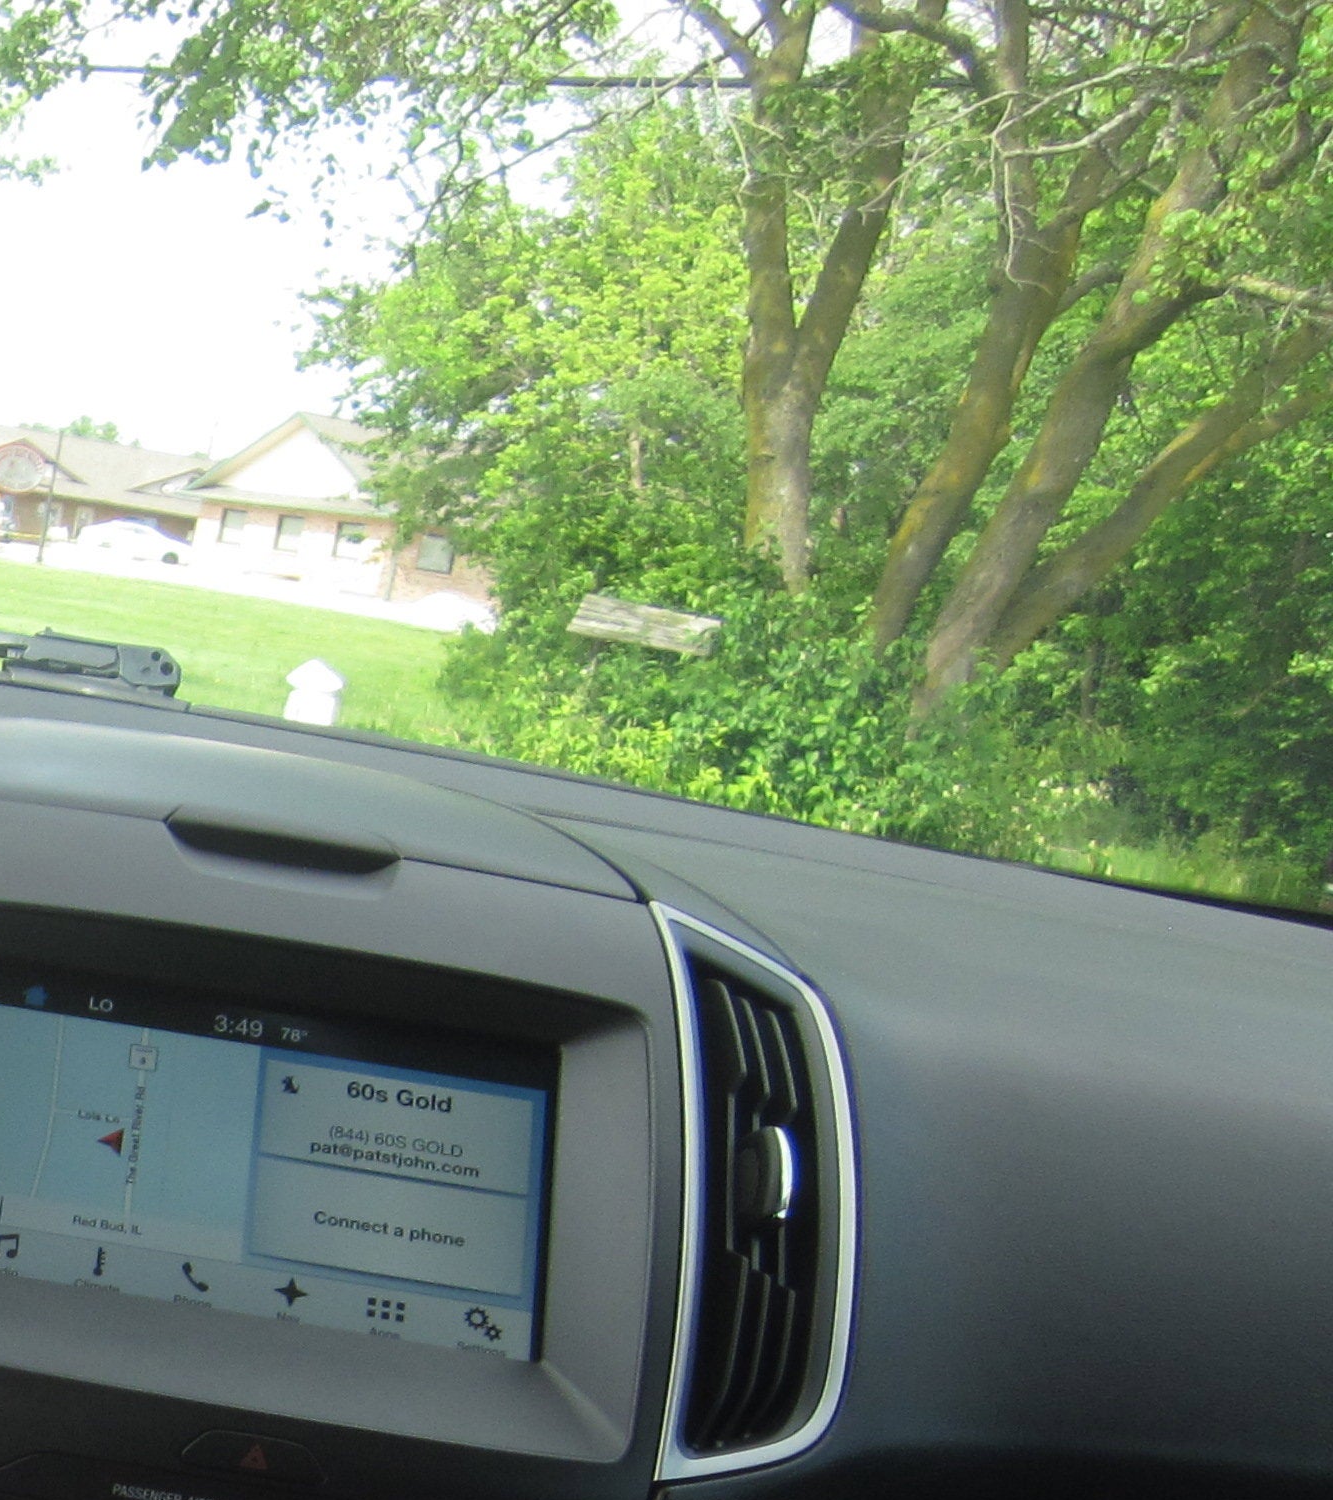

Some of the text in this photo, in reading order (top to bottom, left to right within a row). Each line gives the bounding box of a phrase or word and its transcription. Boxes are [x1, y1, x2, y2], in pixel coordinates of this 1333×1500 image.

[88, 996, 114, 1013] LO
[213, 1014, 263, 1038] 3:49
[346, 1080, 453, 1114] 60s Gold
[131, 1104, 146, 1131] River
[128, 1133, 141, 1164] Great
[328, 1123, 464, 1159] (844) 60S GOLD
[309, 1140, 480, 1179] pat@patstjohn.com
[72, 1215, 143, 1236] Red Bud, IL
[313, 1210, 466, 1249] Connect a phone
